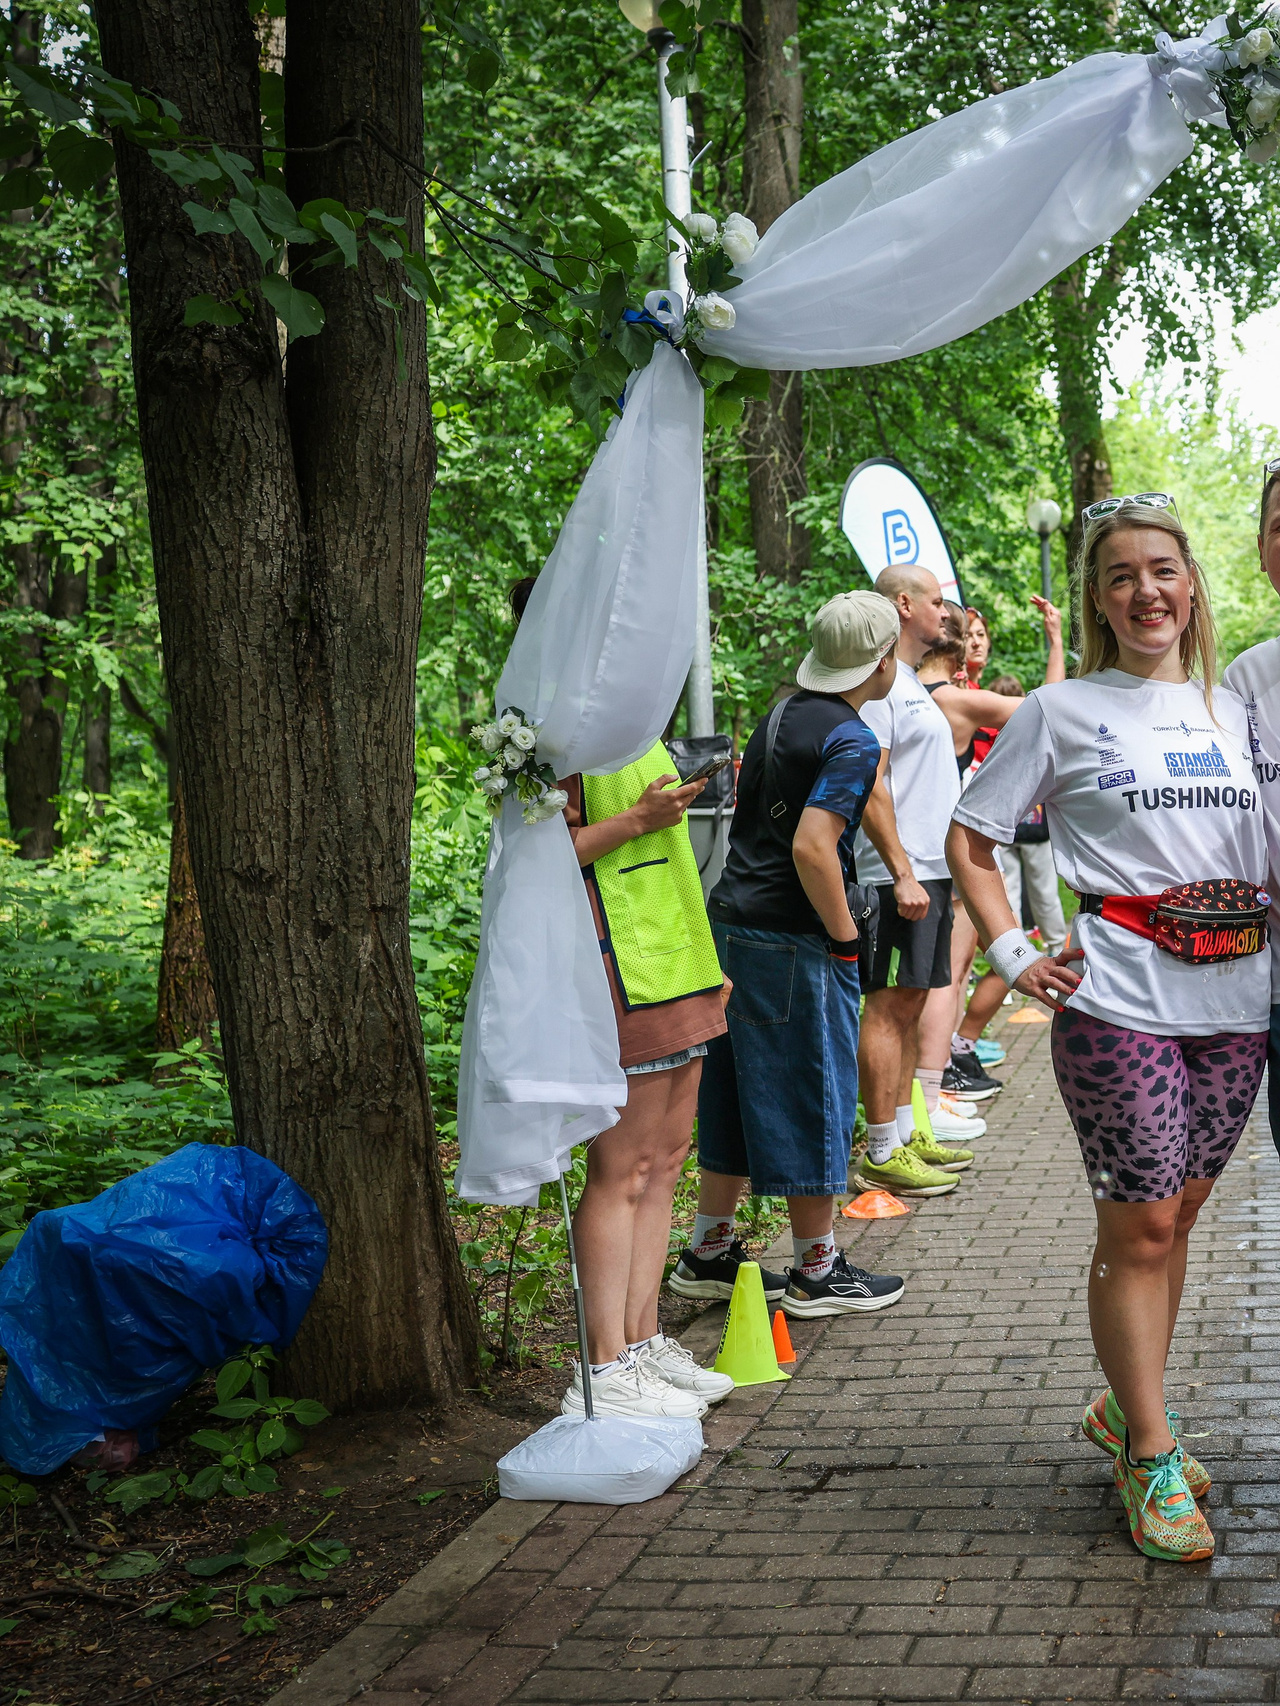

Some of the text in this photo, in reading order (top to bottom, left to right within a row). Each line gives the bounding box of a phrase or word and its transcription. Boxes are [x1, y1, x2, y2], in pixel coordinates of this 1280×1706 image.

[1100, 771, 1133, 784] SPOR
[1167, 767, 1232, 778] YARI MARATONU
[1121, 786, 1257, 813] TUSHINOGI
[1189, 927, 1260, 957] ТУШИНОГИ
